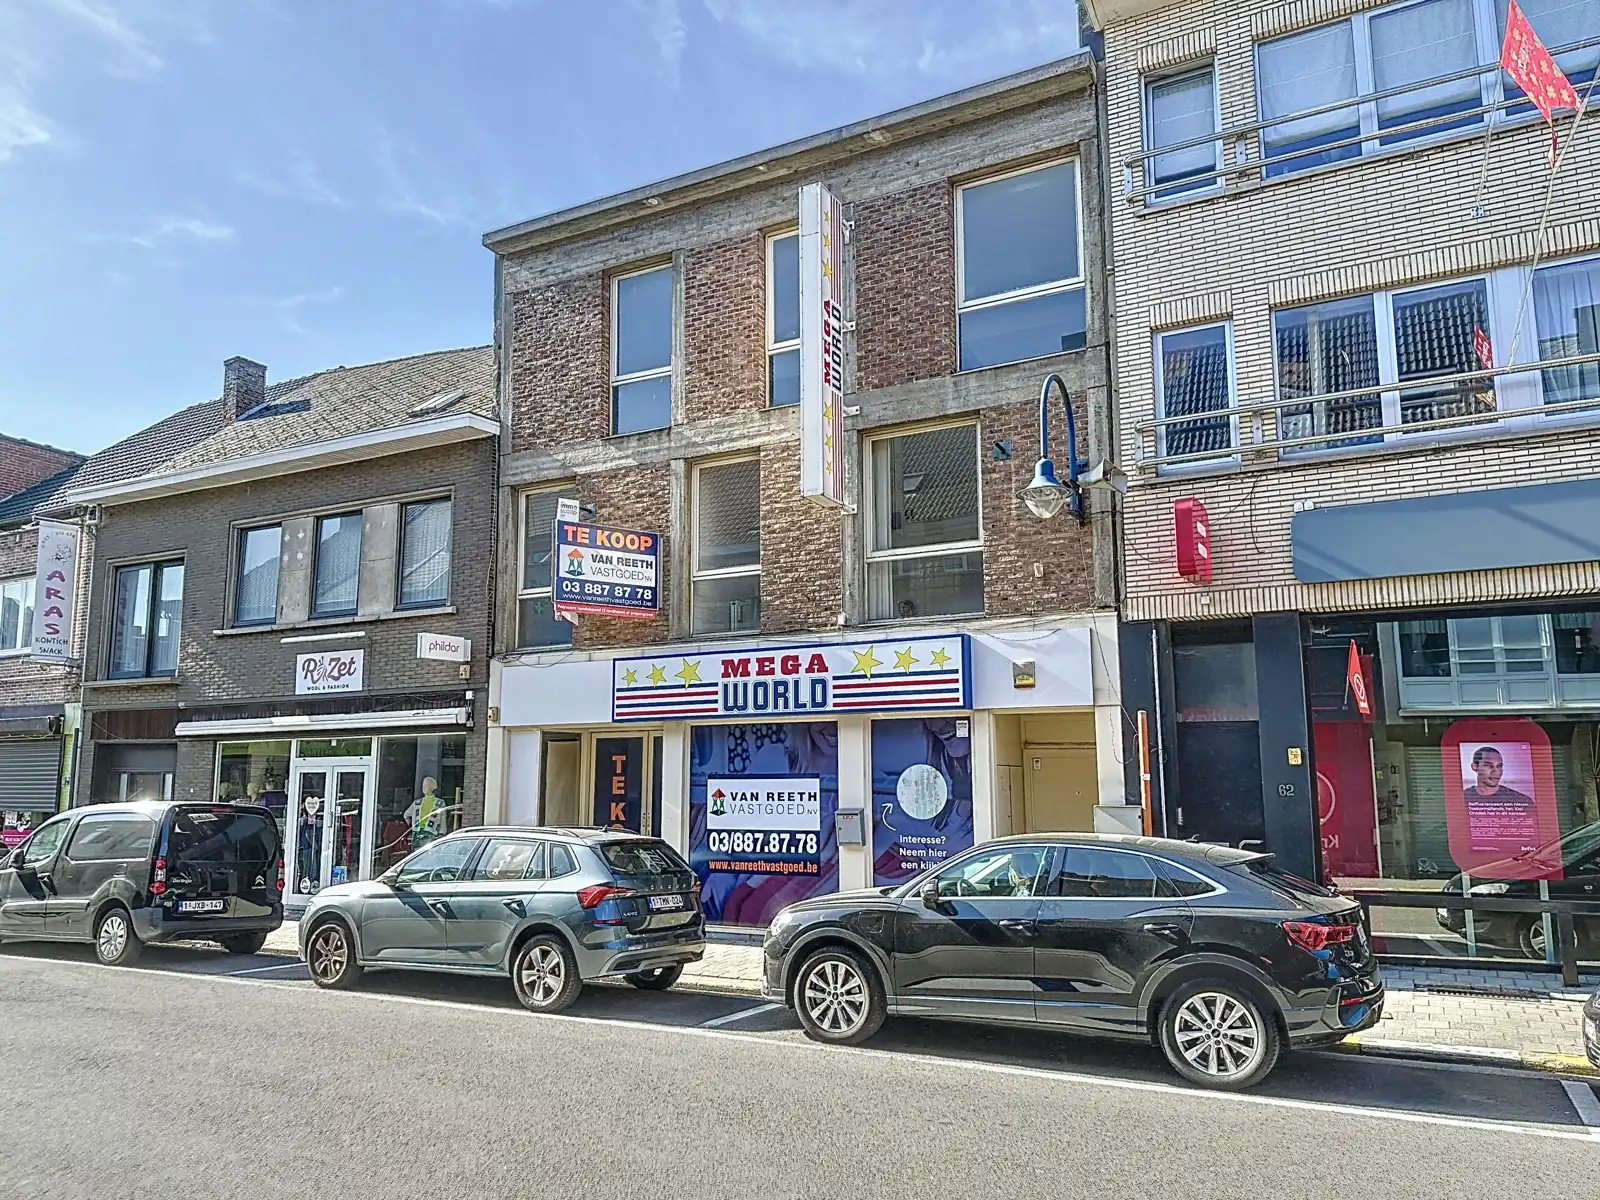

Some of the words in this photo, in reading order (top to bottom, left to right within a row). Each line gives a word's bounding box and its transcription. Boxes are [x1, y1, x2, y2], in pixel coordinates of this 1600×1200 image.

[832, 303, 842, 392] WORLD
[564, 525, 590, 544] TE
[596, 529, 652, 551] KOOP
[591, 554, 612, 565] VAN
[616, 557, 653, 570] REETH
[590, 566, 644, 580] VASTGOED
[562, 581, 580, 592] 03
[584, 583, 610, 595] 887
[615, 586, 631, 598] 87
[636, 589, 652, 600] 78
[562, 594, 652, 606] www.vanreethvastgoed.be
[721, 653, 828, 678] MEGA
[721, 676, 829, 713] WORLD
[612, 756, 626, 794] TE
[730, 792, 759, 802] VAN
[766, 792, 817, 802] REETH
[1279, 784, 1294, 796] 62
[611, 802, 626, 828] K
[730, 804, 804, 814] VASTGOED
[709, 832, 817, 854] 03/887.87.78
[900, 835, 946, 844] Interesse?
[900, 848, 926, 857] Neem
[928, 848, 947, 857] hier
[709, 861, 818, 874] www.vanreethvastgoed.be
